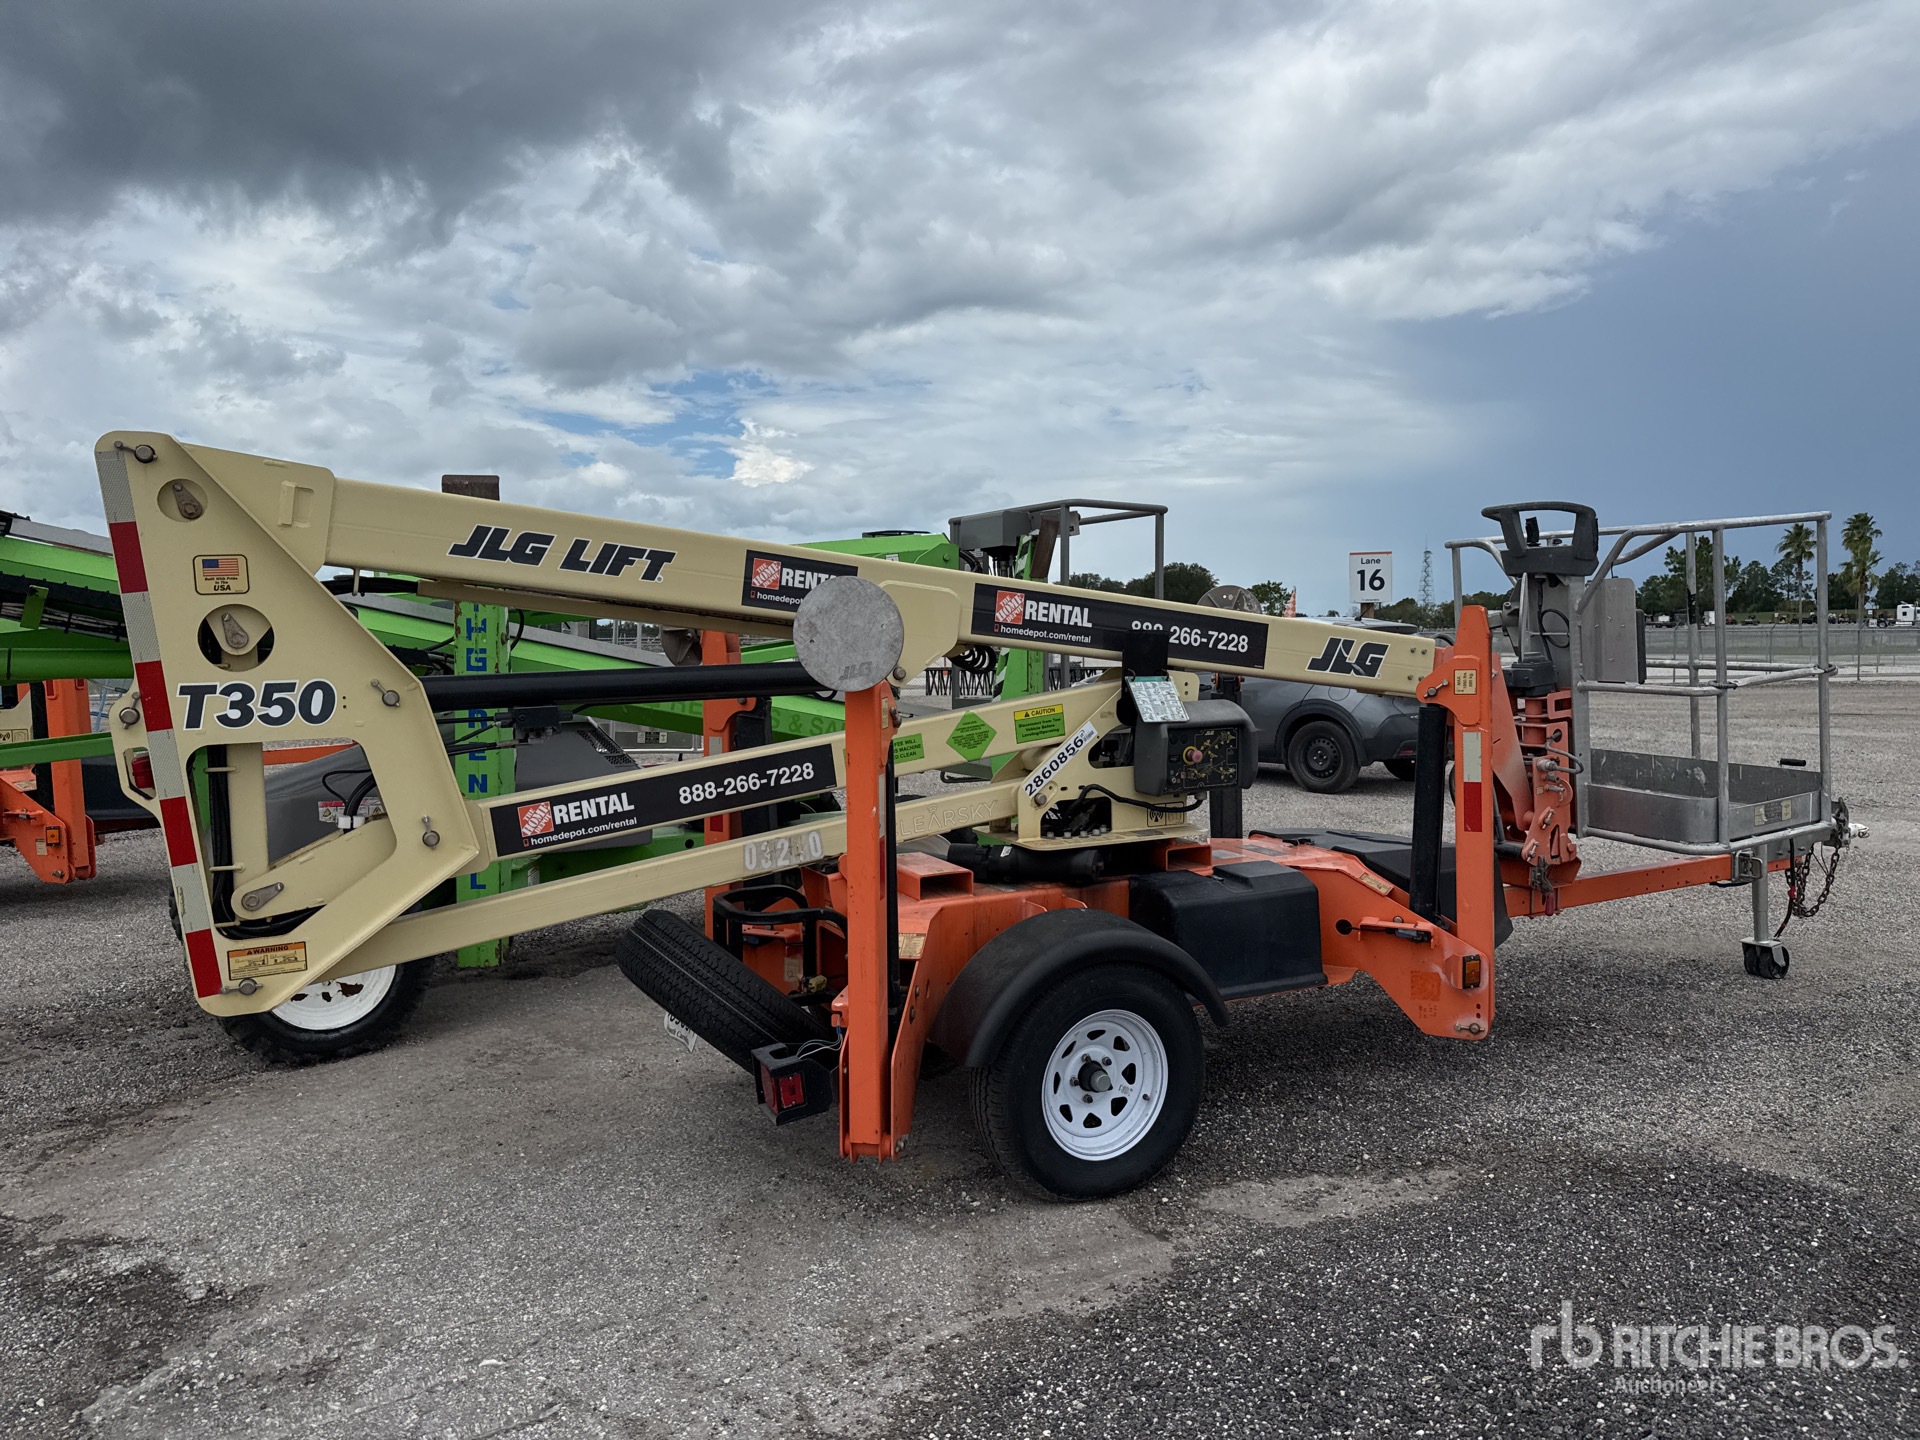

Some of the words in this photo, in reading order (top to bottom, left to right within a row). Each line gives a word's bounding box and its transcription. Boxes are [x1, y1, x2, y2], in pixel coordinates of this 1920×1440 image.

[447, 524, 556, 567] JLG
[560, 538, 677, 582] LIFT
[752, 562, 781, 587] HOME
[757, 563, 768, 574] THE
[781, 568, 836, 589] RENT
[1357, 569, 1385, 591] 16
[763, 573, 780, 588] DEPOT
[995, 593, 1024, 622] HOME
[1000, 595, 1012, 607] THE
[1006, 606, 1024, 623] DEPOT
[1024, 600, 1092, 628] RENTAL
[1000, 625, 1091, 644] homedepot.com/rental
[1305, 636, 1390, 679] JLG
[839, 661, 872, 680] JLG
[177, 680, 336, 731] T350
[1031, 708, 1056, 716] CAUTION
[899, 744, 922, 752] MACHINE
[1025, 736, 1083, 796] 2860856
[679, 762, 814, 804] 888-266-7228
[522, 802, 550, 836] HOME
[524, 808, 535, 822] THE
[553, 792, 634, 825] RENTAL
[896, 800, 998, 836] LEARSKY
[530, 817, 637, 845] homedepot.com/rental
[535, 814, 552, 834] DEPOT
[744, 831, 821, 870] 0320
[252, 945, 289, 954] WARNING
